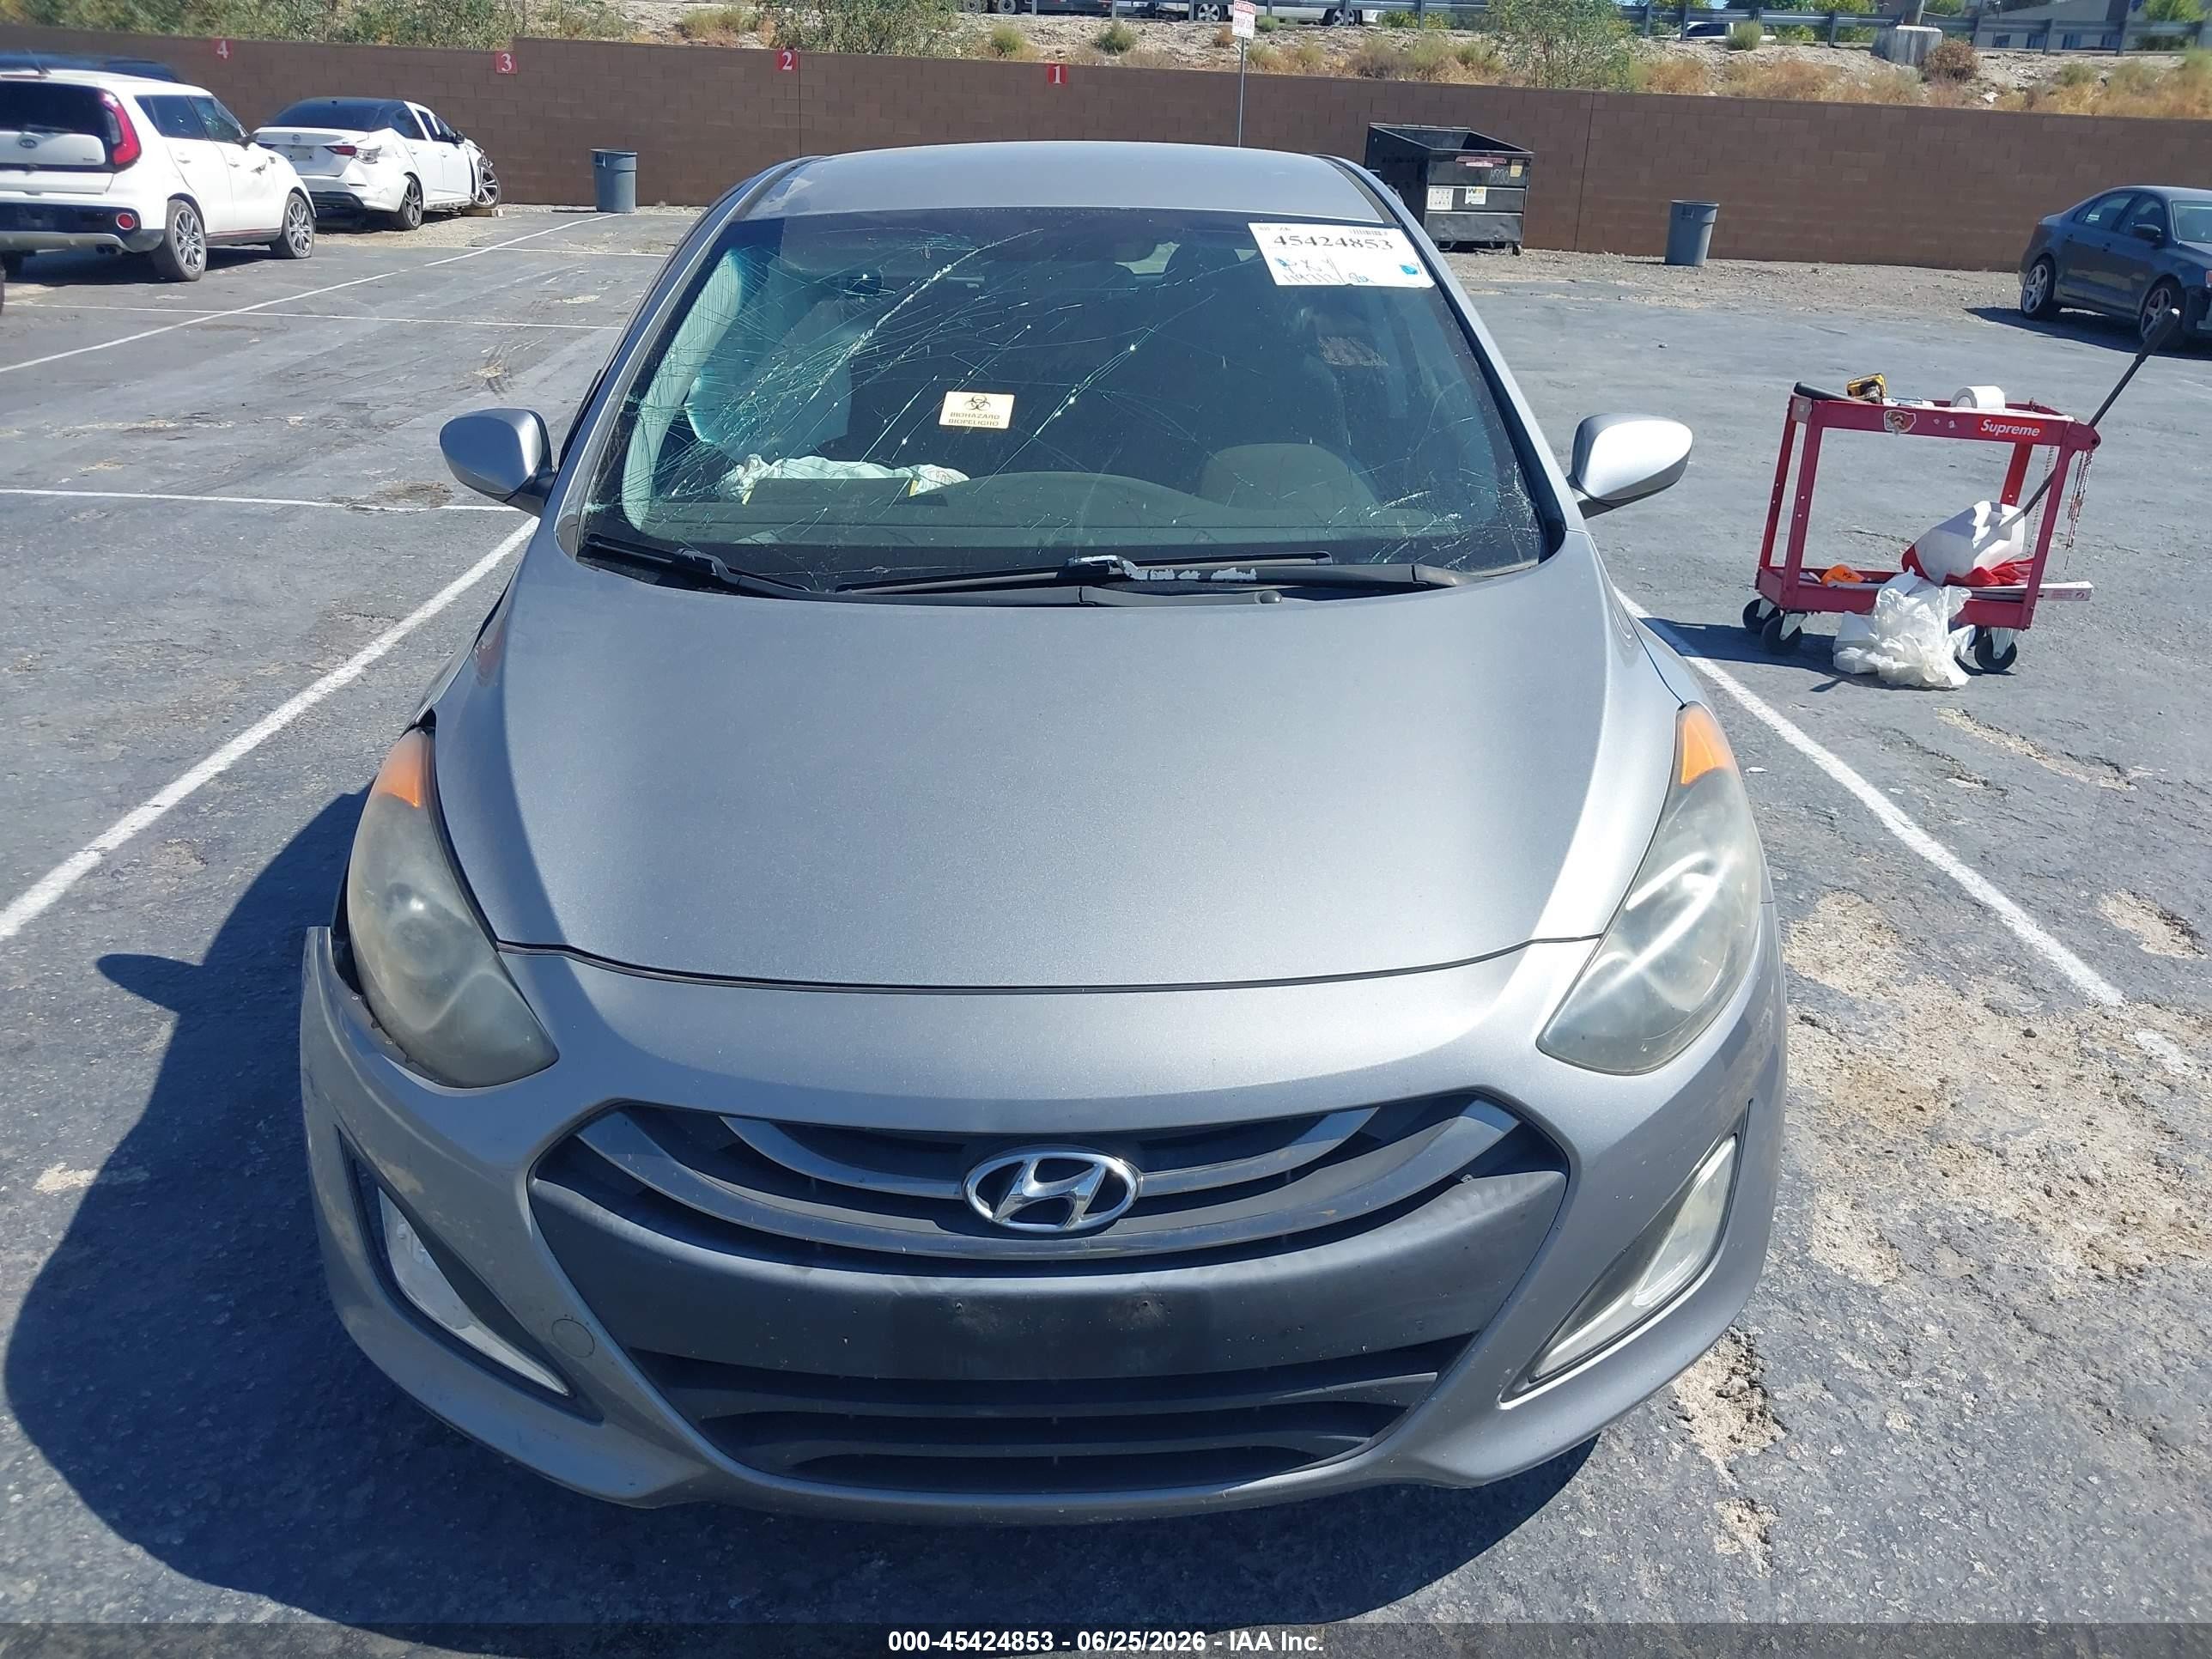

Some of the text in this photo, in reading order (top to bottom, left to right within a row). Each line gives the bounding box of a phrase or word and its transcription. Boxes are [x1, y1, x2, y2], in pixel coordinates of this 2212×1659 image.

[217, 40, 228, 58] 4
[501, 53, 512, 71] 3
[782, 52, 793, 70] 2
[1053, 64, 1063, 84] 1
[1273, 234, 1394, 250] 45424853
[1980, 419, 2040, 436] Supreme
